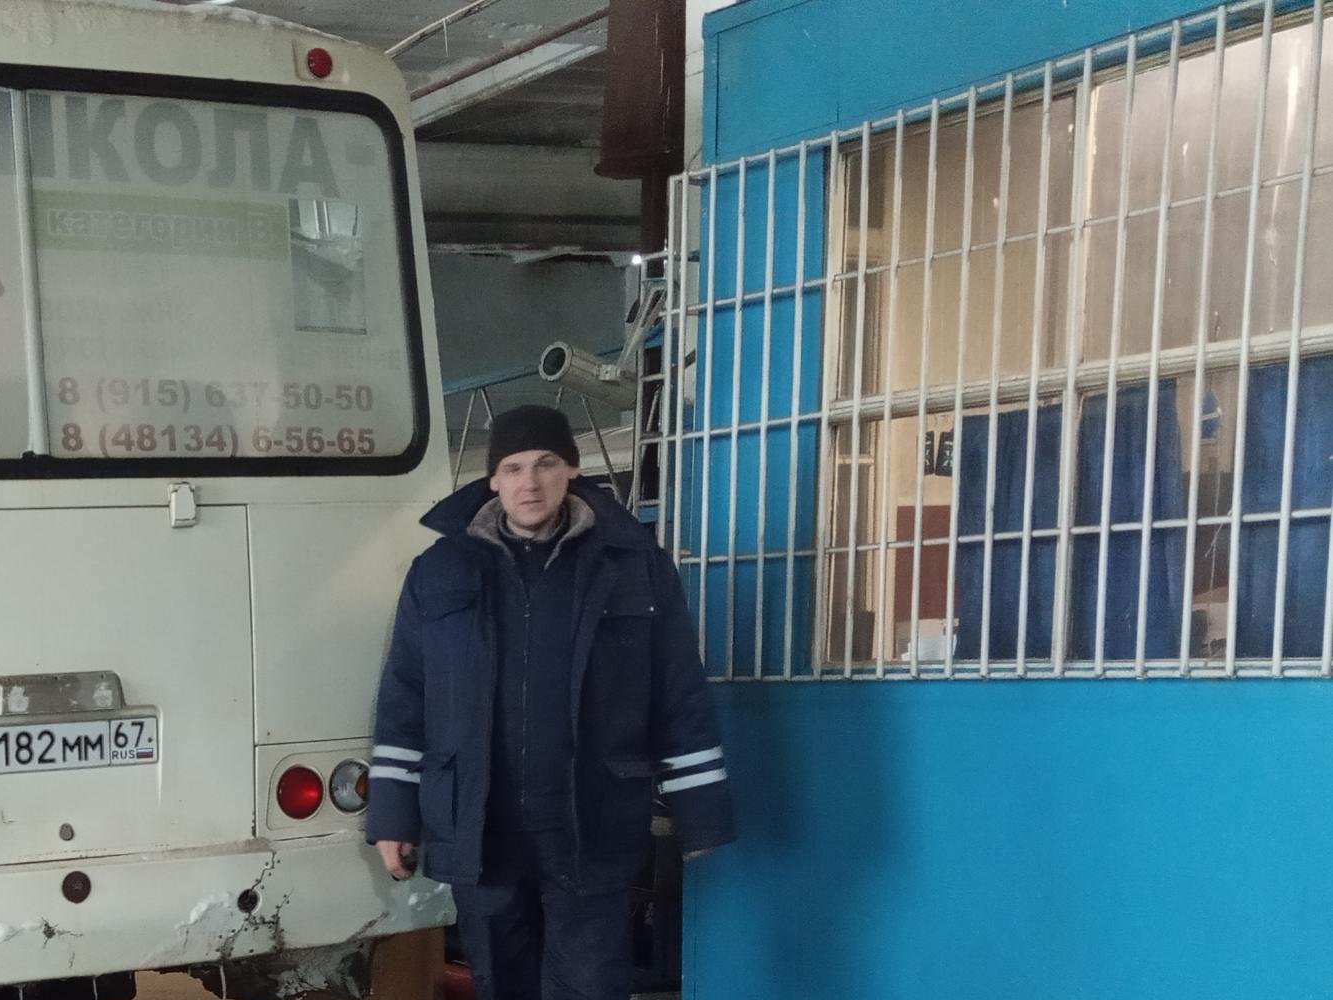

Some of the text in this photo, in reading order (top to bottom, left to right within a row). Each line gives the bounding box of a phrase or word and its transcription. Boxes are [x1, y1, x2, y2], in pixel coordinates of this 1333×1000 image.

[58, 376, 80, 405] 8
[96, 378, 191, 412] (915)
[61, 423, 376, 457] 8 (48134) 6-56-65
[113, 722, 144, 748] 67
[112, 750, 135, 760] RUS
